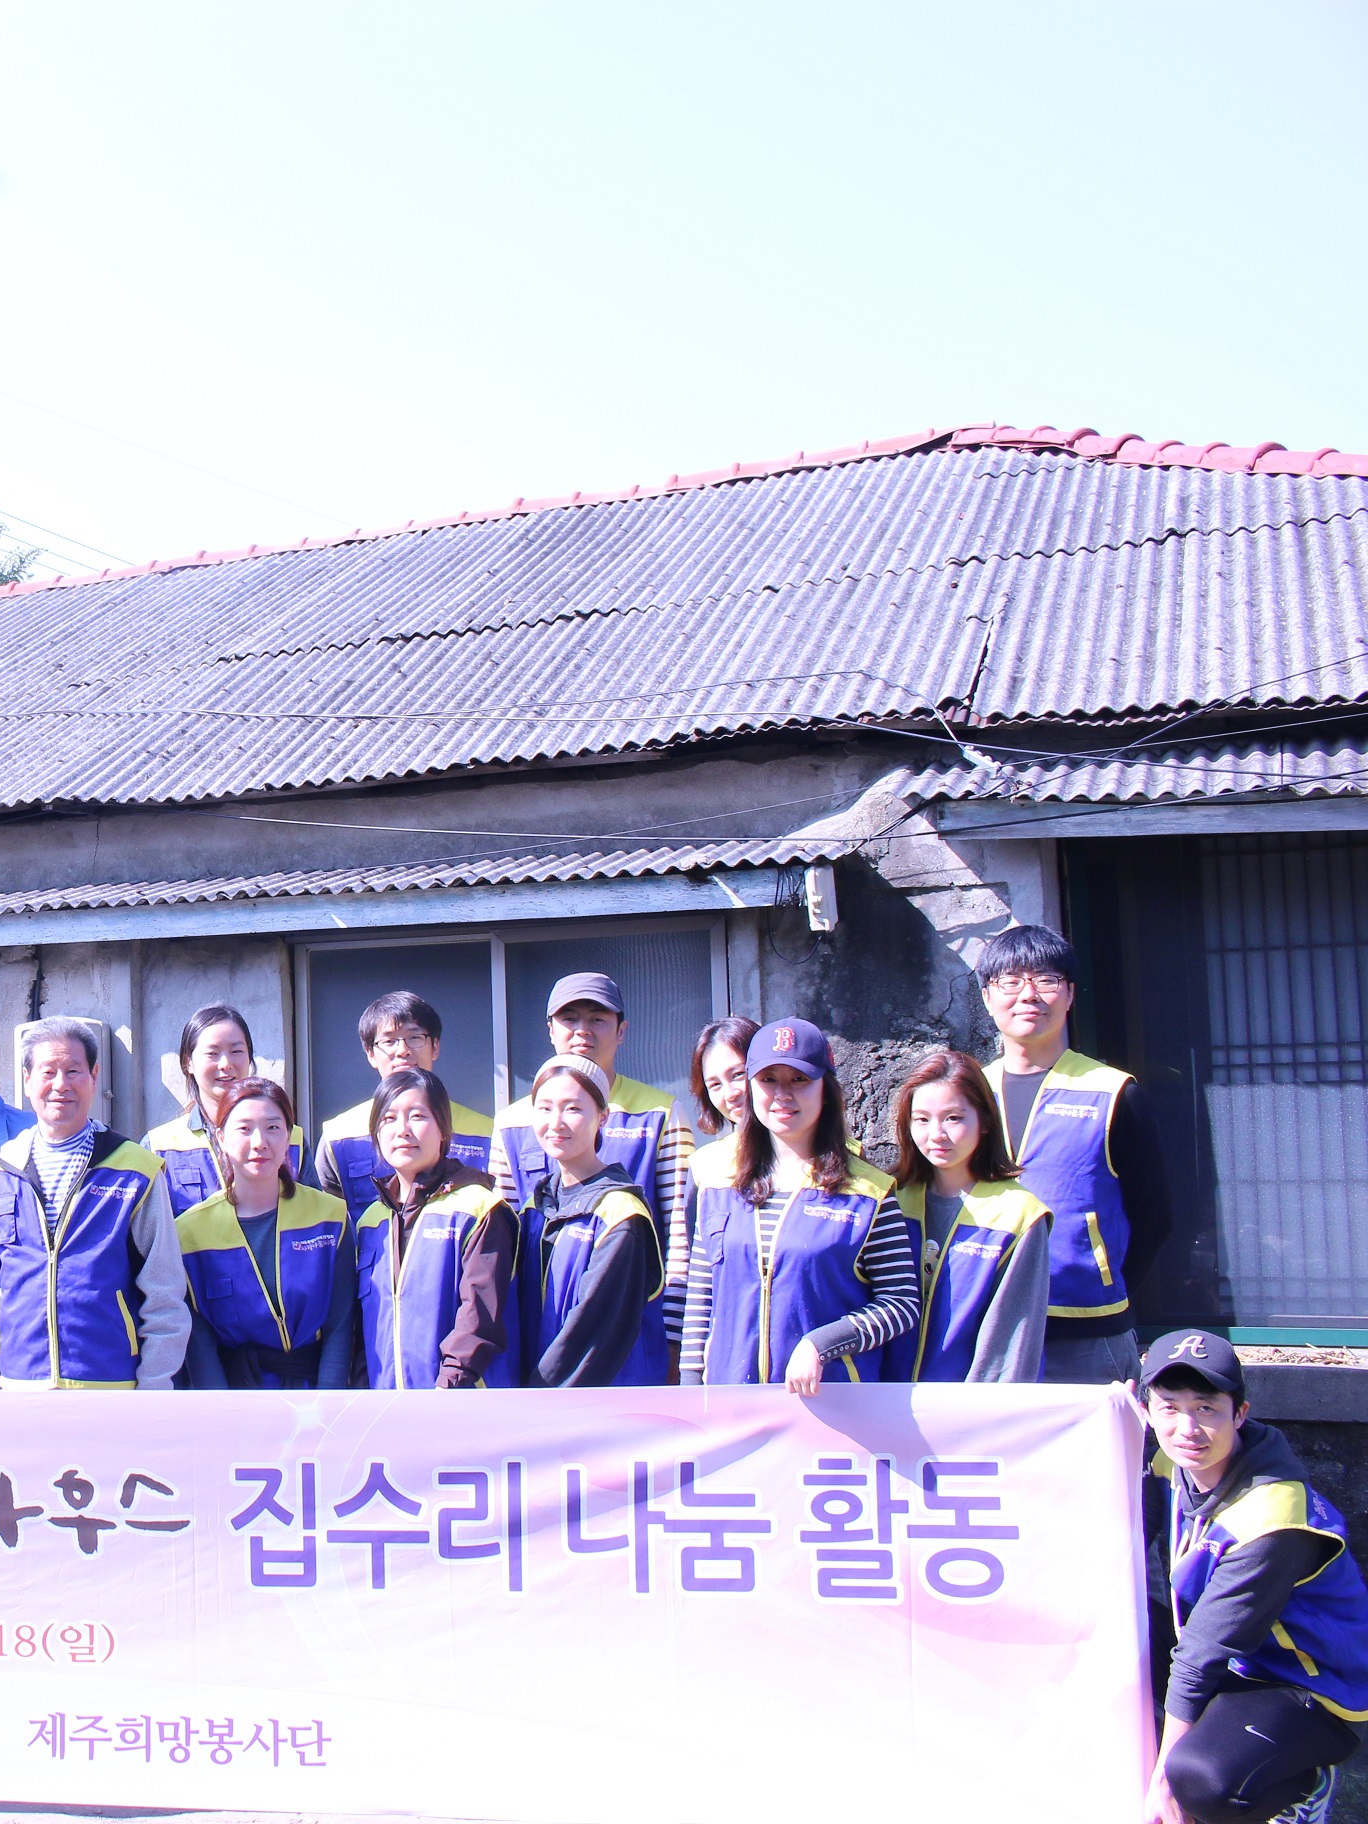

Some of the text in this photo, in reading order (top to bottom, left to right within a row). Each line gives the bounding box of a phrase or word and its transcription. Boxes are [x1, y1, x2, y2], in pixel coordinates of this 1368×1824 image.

[773, 1026, 795, 1051] B
[1167, 1335, 1209, 1360] A
[231, 1461, 523, 1592] 집수리
[566, 1461, 772, 1592] 나눔
[800, 1458, 1020, 1598] 활동
[27, 1712, 332, 1768] 제주희망봉사단
